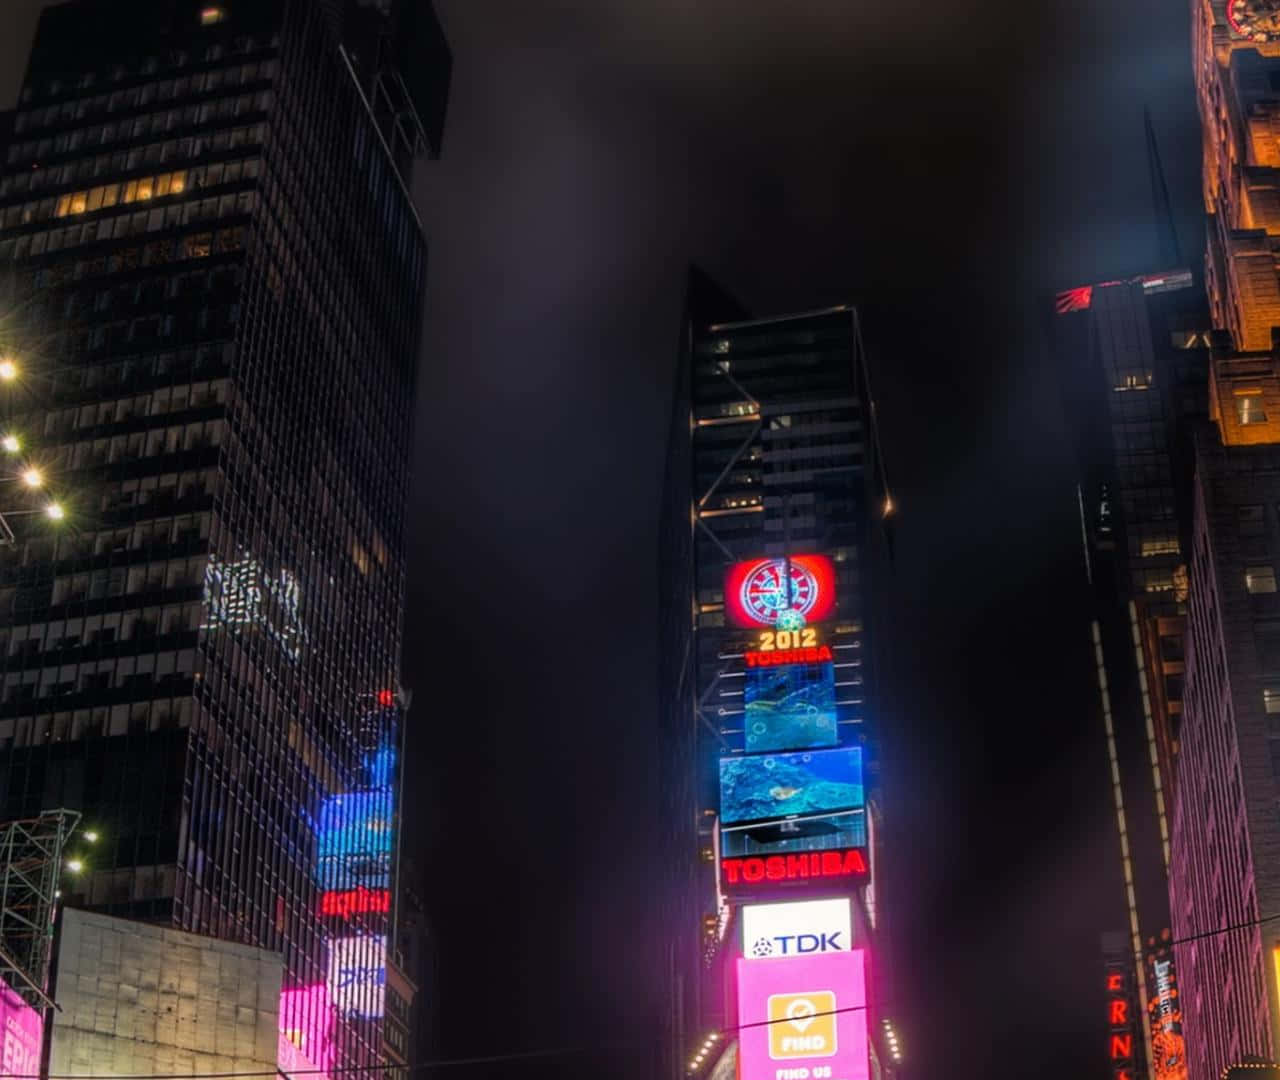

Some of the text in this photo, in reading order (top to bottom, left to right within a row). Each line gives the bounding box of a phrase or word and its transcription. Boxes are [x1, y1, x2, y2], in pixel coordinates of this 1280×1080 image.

[760, 629, 817, 651] 2012
[745, 646, 833, 667] TOSHIBA
[722, 850, 866, 883] TOSHIBA
[774, 932, 843, 955] TDK
[782, 1036, 826, 1052] FIND
[776, 1066, 832, 1080] FIND US
